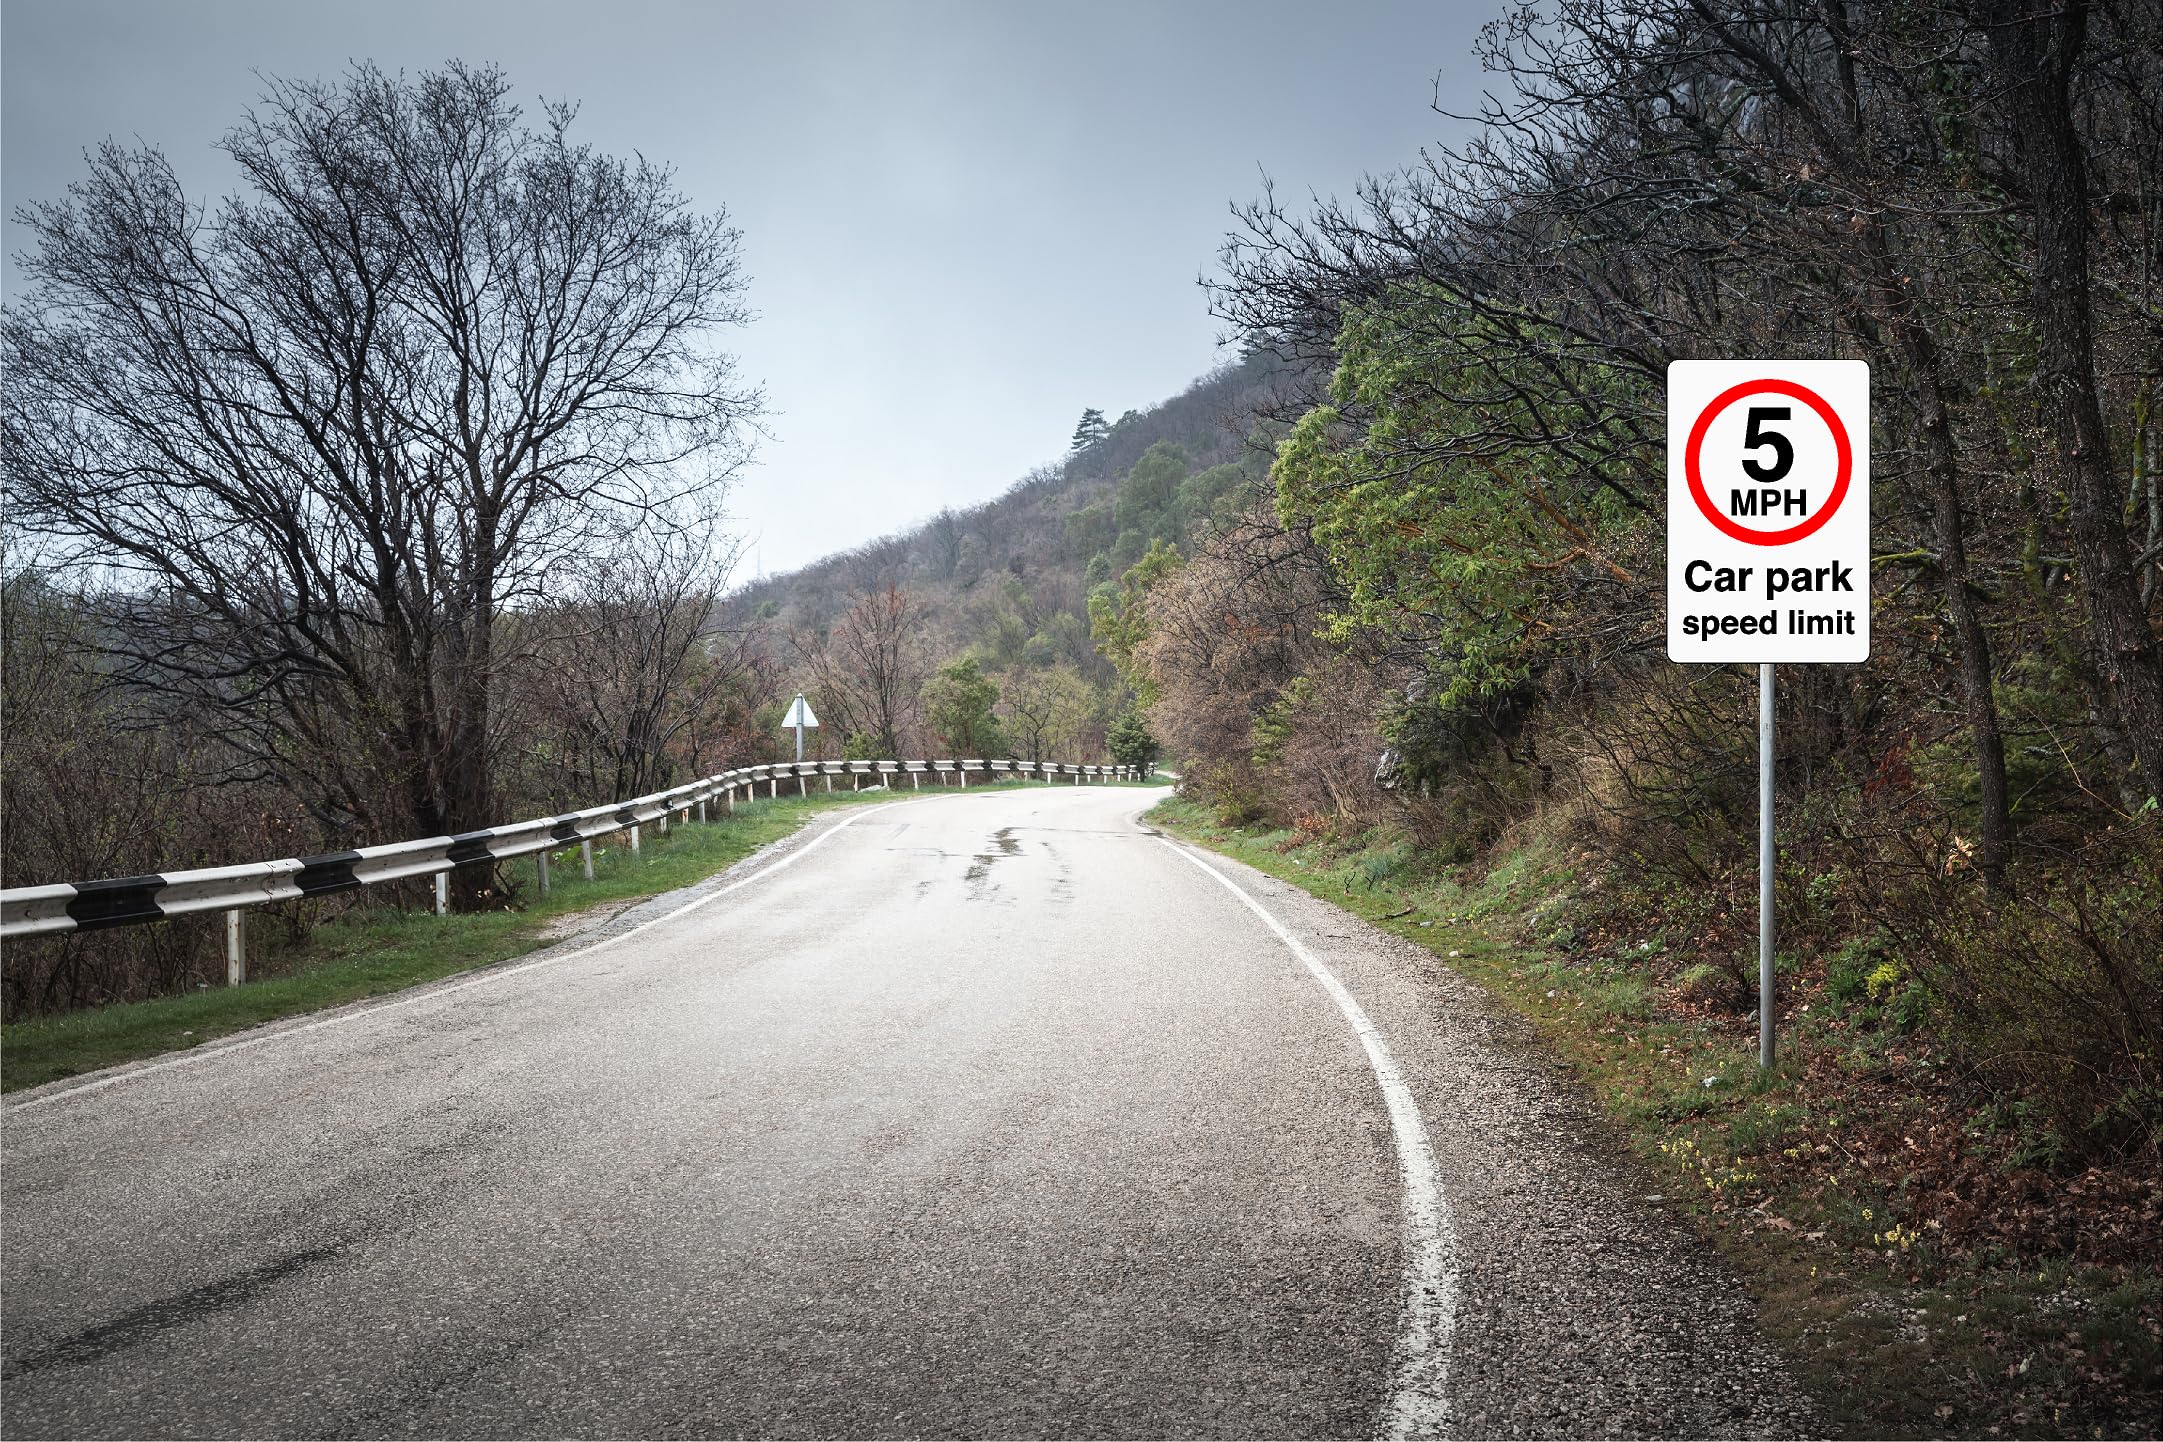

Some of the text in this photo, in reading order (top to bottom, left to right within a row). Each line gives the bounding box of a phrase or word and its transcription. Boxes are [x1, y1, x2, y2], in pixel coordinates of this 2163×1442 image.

[1741, 406, 1795, 484] 5
[1730, 488, 1807, 517] MPH
[1684, 559, 1854, 601] Car park
[1682, 609, 1856, 642] speed limit
